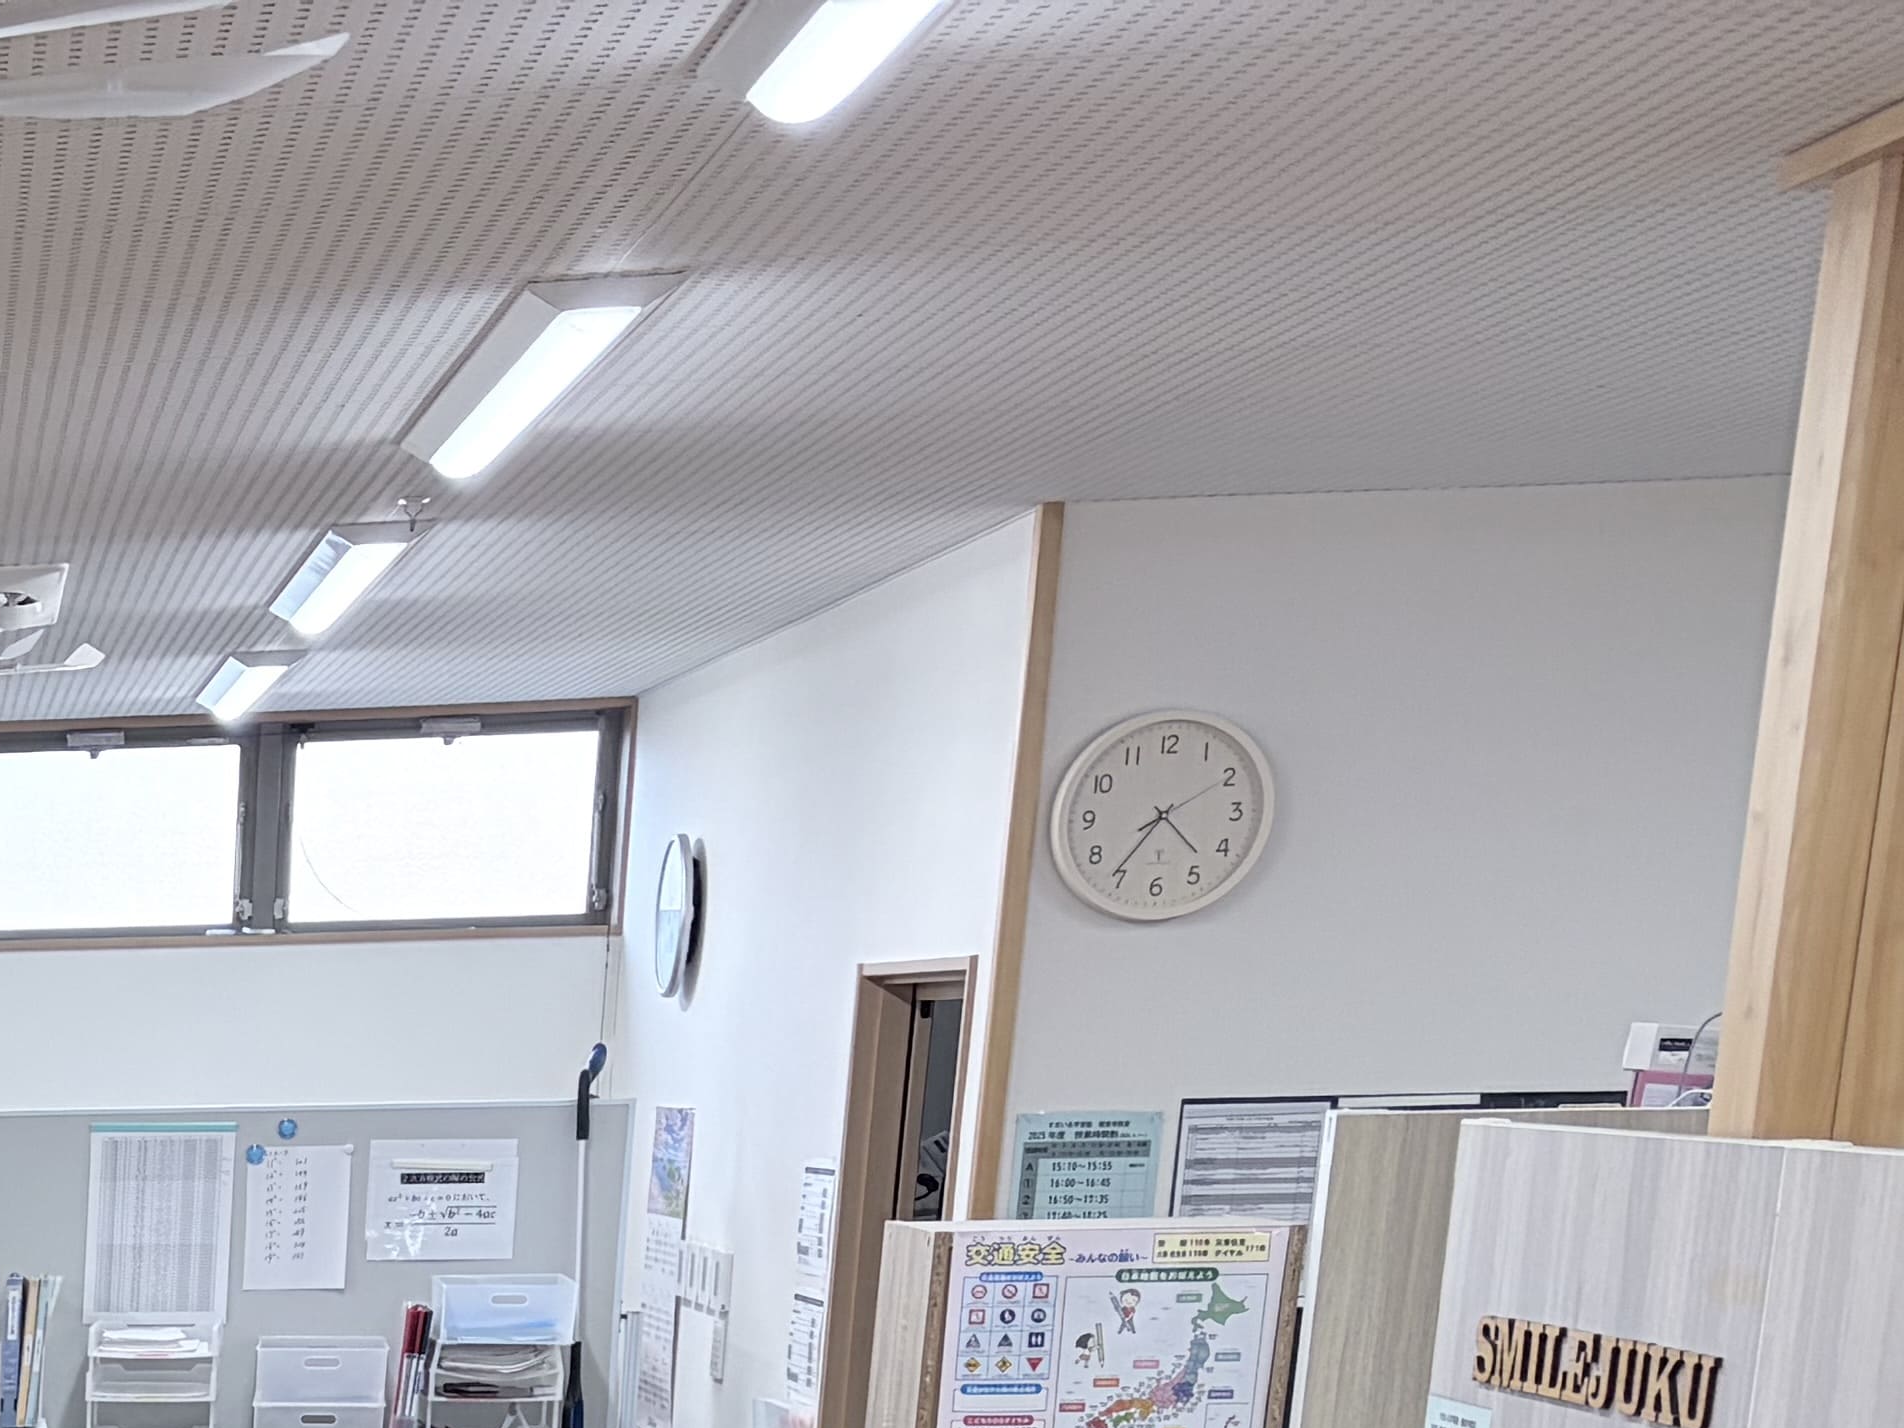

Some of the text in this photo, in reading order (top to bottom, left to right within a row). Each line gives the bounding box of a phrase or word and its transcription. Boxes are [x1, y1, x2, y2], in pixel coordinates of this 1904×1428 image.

[1161, 734, 1179, 754] 12
[1204, 742, 1209, 762] 1
[1124, 746, 1140, 766] 11
[1093, 774, 1113, 794] 10
[1223, 767, 1236, 787] 2
[1082, 810, 1096, 830] 9
[1229, 802, 1243, 821] 3
[1089, 845, 1102, 865] 8
[1216, 838, 1229, 857] 4
[1113, 869, 1127, 888] 7
[1187, 866, 1201, 885] 5
[1149, 877, 1163, 896] 6
[965, 1242, 1066, 1266] 交通安全
